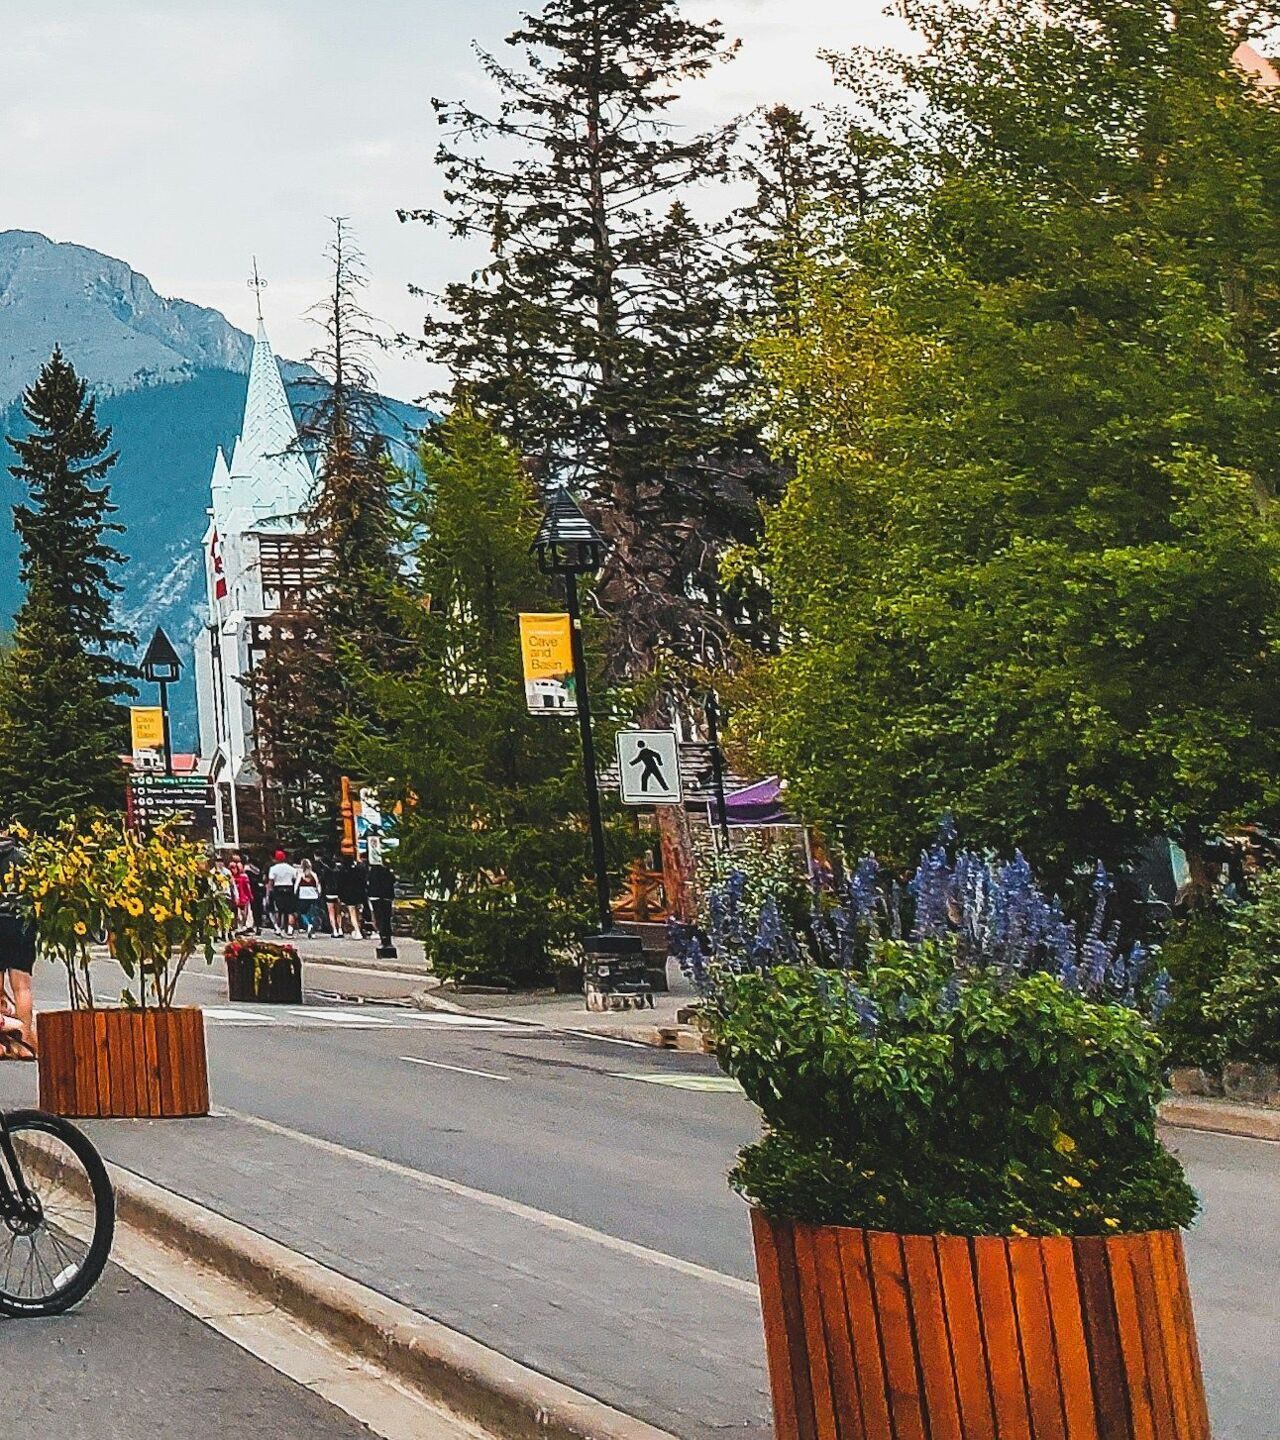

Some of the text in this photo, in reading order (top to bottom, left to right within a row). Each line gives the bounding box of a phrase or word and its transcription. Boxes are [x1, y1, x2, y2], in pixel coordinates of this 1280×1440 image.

[529, 635, 558, 648] Cave
[530, 647, 552, 658] and
[531, 658, 562, 671] Basin
